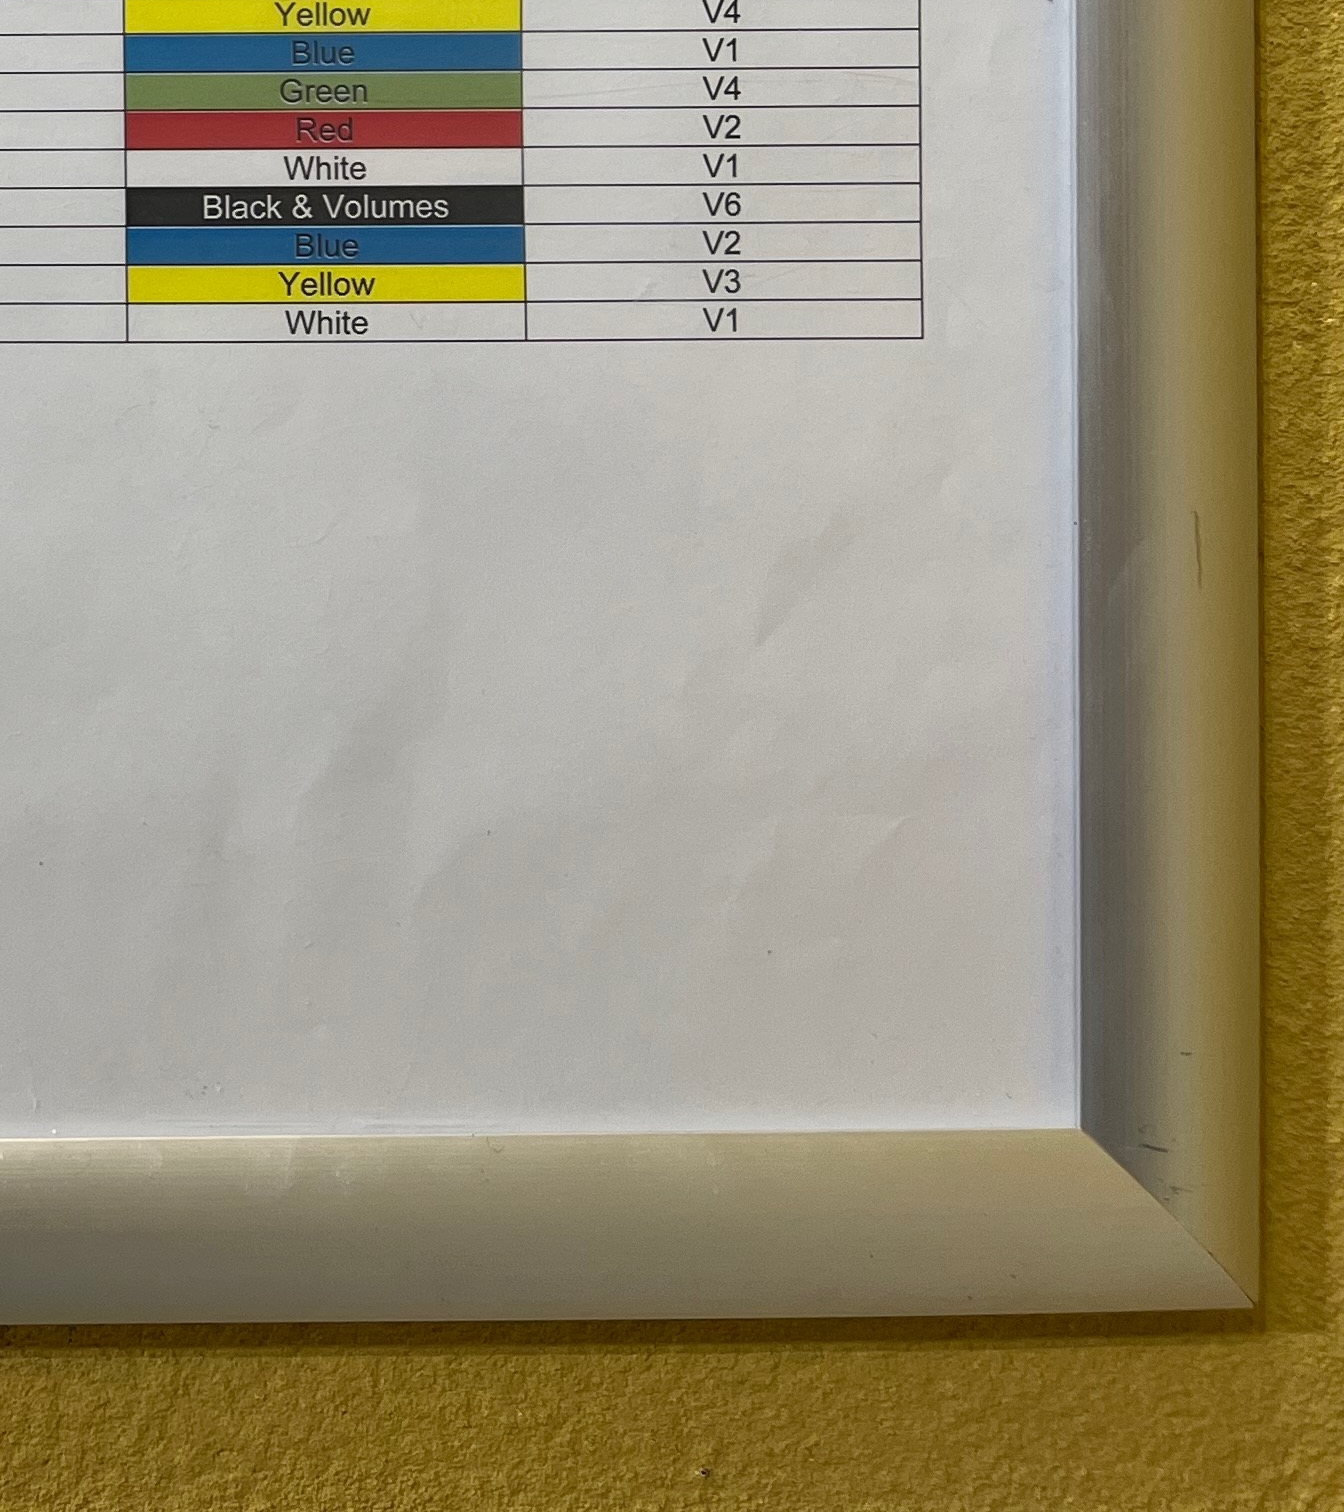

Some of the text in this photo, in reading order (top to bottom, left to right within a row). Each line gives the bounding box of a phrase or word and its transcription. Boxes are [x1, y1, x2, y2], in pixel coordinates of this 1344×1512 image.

[296, 116, 353, 141] Red
[702, 114, 741, 140] V2
[203, 194, 449, 220] Black & Volumes
[702, 191, 742, 217] V6
[284, 310, 369, 335] White
[702, 307, 737, 333] V1
